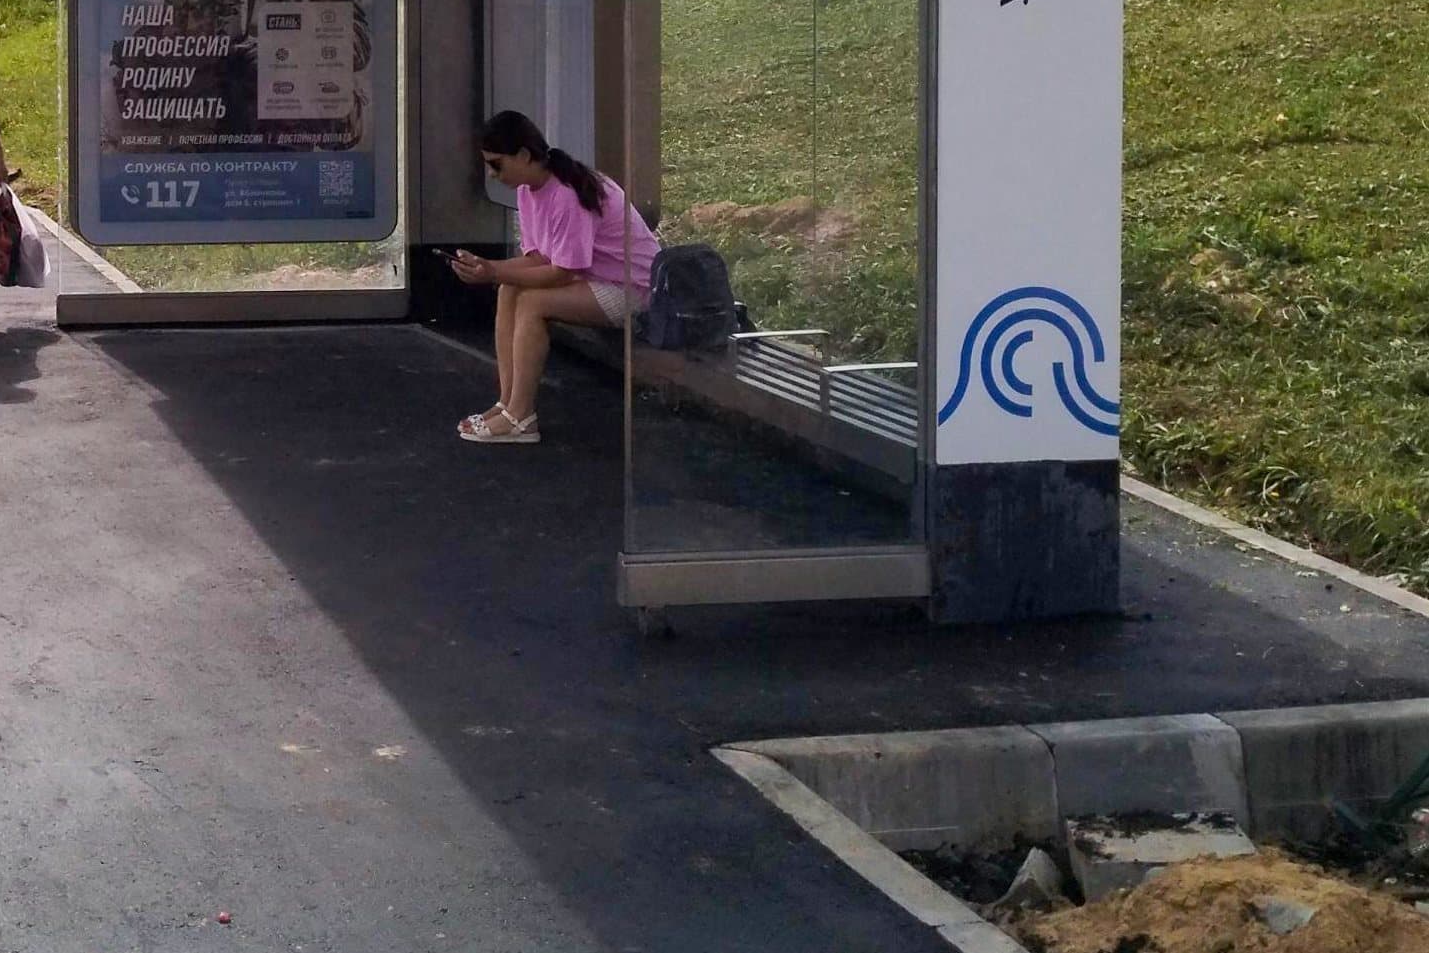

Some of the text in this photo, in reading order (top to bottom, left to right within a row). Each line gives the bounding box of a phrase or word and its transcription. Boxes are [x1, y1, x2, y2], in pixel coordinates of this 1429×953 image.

[121, 5, 174, 26] НАША
[121, 35, 231, 57] ПРОФЕССИЯ
[121, 66, 196, 91] РОДИНУ
[122, 97, 227, 122] ЗАЩИЩАТЬ
[121, 135, 162, 145] УВАЖЕНИЕ
[218, 133, 264, 145] ПРОФЕССИЯ
[124, 160, 299, 174] СЛУЖБА ПО КОНТРАКТУ
[146, 180, 200, 208] 117
